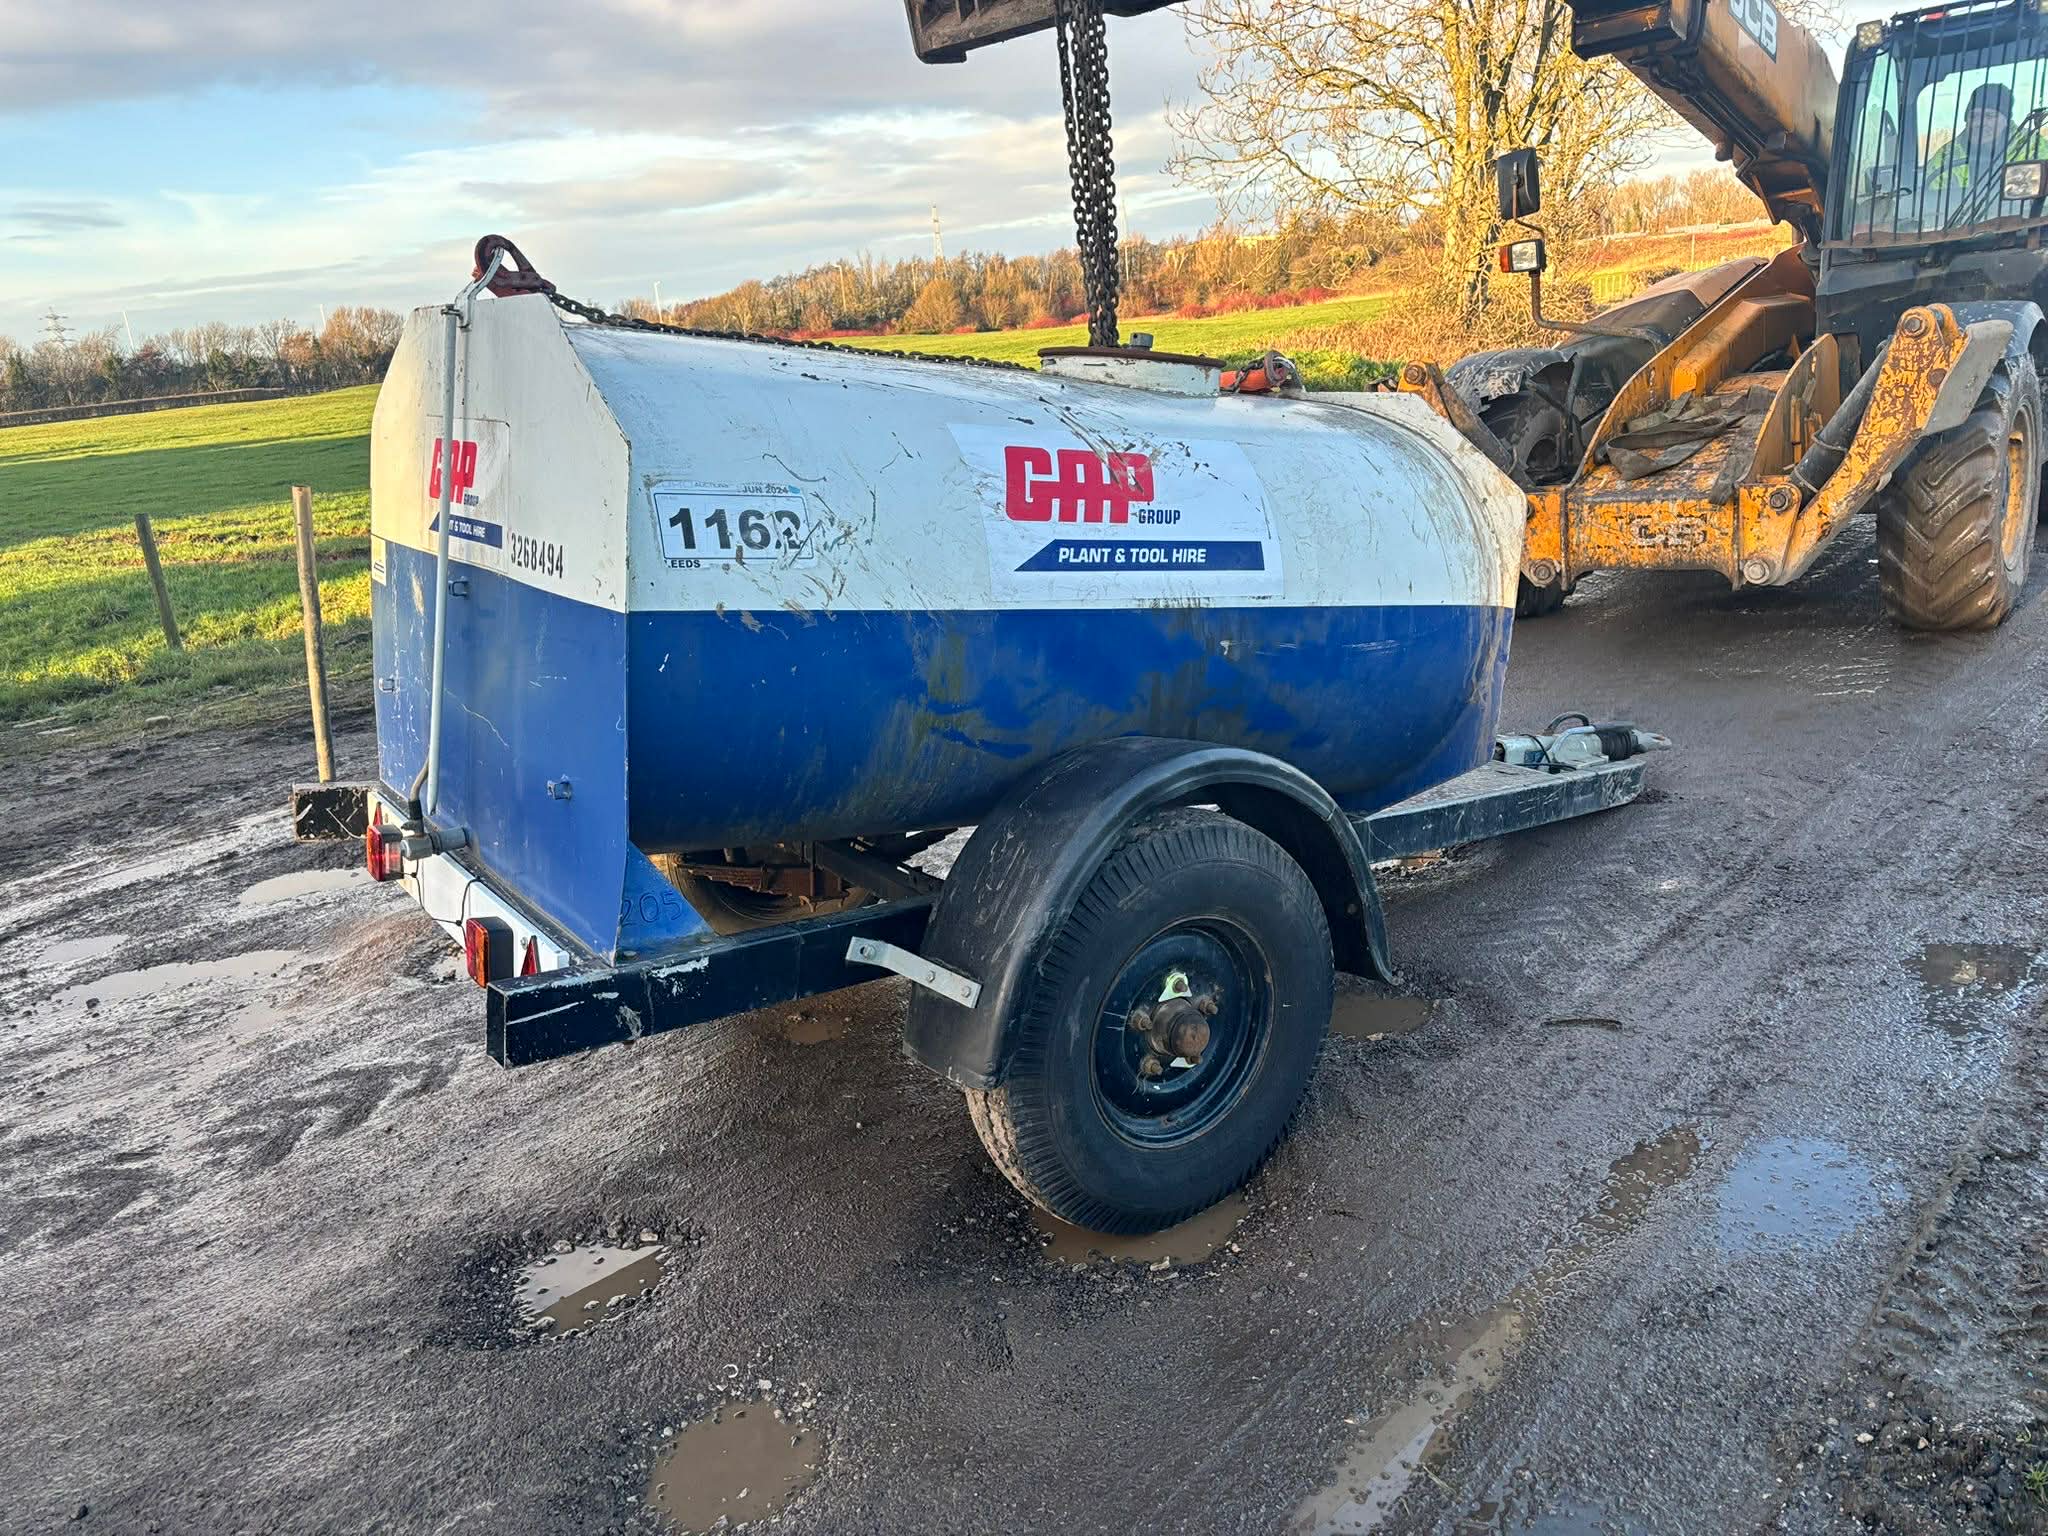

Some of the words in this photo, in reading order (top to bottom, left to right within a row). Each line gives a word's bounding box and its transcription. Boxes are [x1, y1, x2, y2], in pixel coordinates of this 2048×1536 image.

[1004, 446, 1154, 524] GAP
[1138, 508, 1181, 525] GROUP
[511, 532, 563, 579] 3268494
[1058, 547, 1111, 563] PLANT
[1115, 548, 1126, 563] &
[1130, 548, 1168, 564] TOOL
[1172, 548, 1206, 563] HIRE
